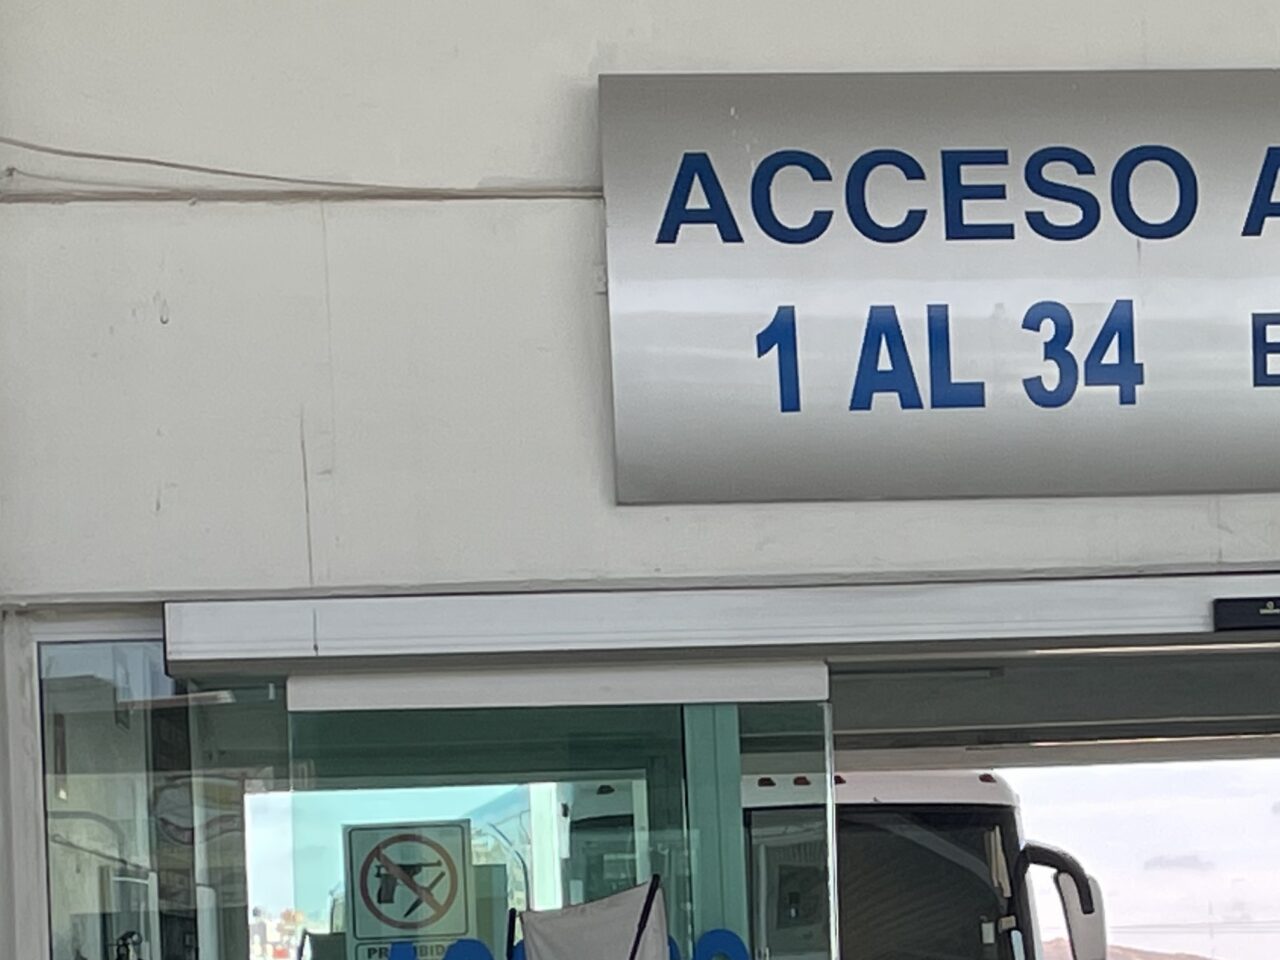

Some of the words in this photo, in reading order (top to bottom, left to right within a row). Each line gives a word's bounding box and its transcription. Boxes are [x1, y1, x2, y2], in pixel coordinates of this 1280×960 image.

[656, 146, 1198, 244] ACCESO
[755, 305, 800, 413] 1
[848, 303, 985, 412] AL
[1022, 299, 1144, 408] 34
